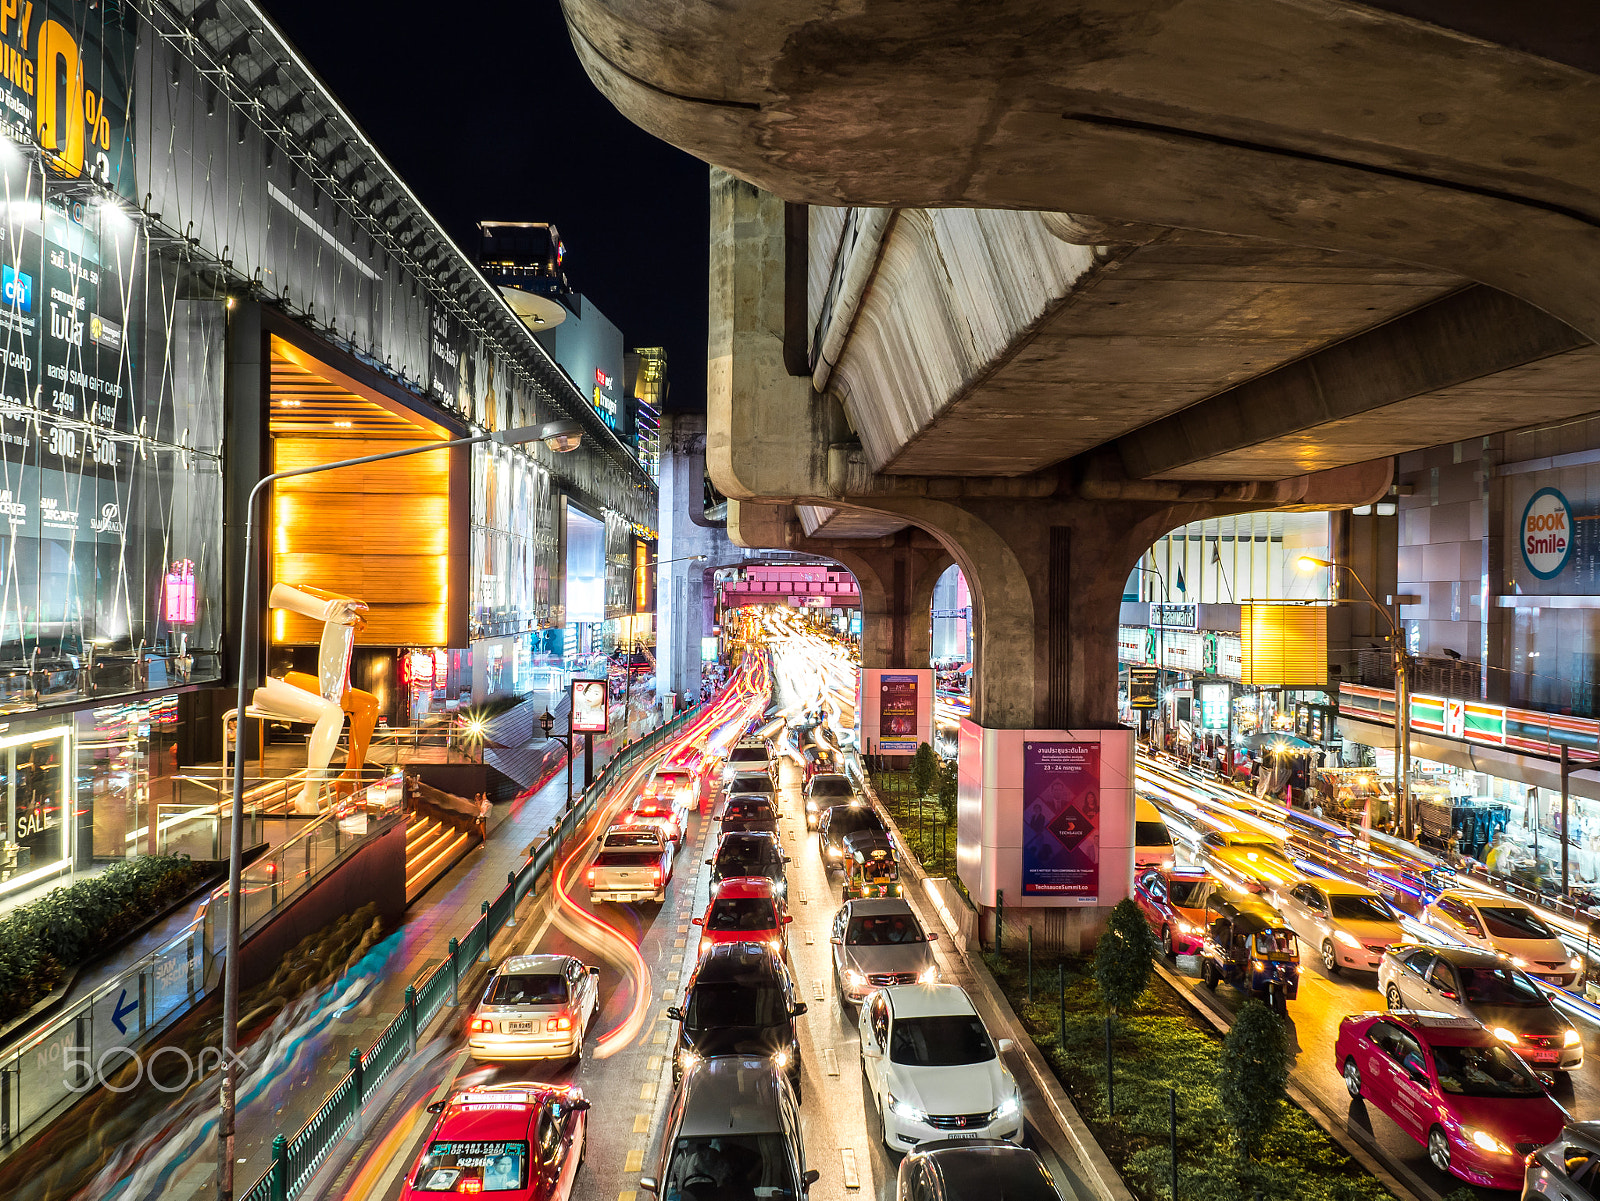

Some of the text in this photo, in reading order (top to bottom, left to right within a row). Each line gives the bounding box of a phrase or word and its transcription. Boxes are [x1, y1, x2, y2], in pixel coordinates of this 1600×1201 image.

[9, 351, 32, 373] CARD
[70, 371, 88, 388] SIAM
[89, 376, 104, 393] GIFT
[104, 381, 123, 399] CARD
[1527, 512, 1565, 532] BOOK
[1527, 534, 1566, 555] Smile
[17, 811, 52, 838] SALE
[37, 1031, 75, 1070] NOW
